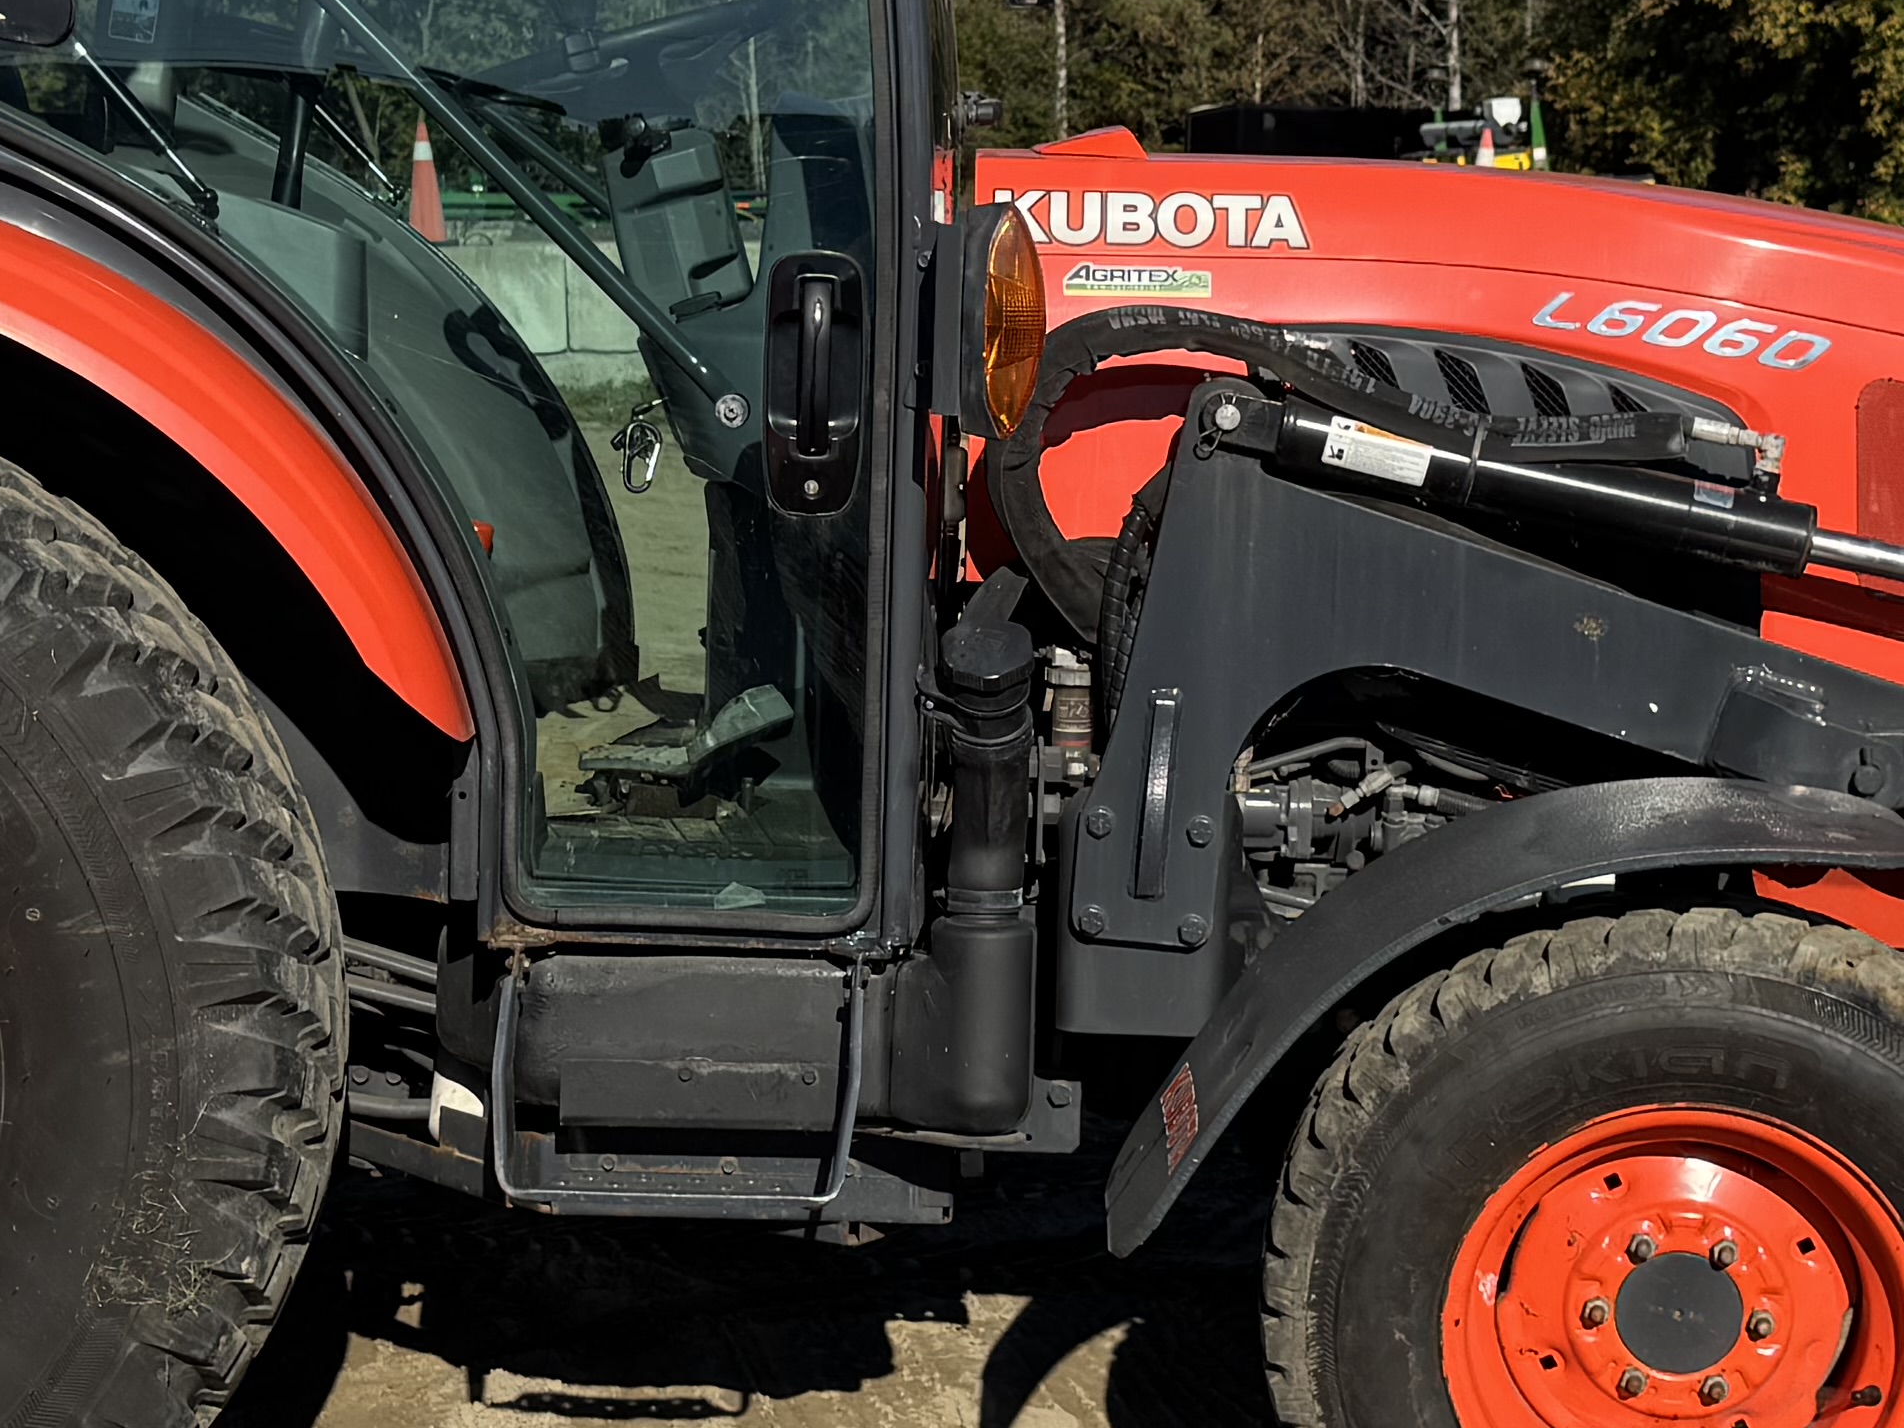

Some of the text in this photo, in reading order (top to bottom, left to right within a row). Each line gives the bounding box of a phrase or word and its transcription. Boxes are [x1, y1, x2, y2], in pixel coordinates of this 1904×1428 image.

[993, 189, 1309, 249] KUBOTA
[1067, 264, 1179, 283] AGRITEX
[1532, 292, 1832, 371] L6060
